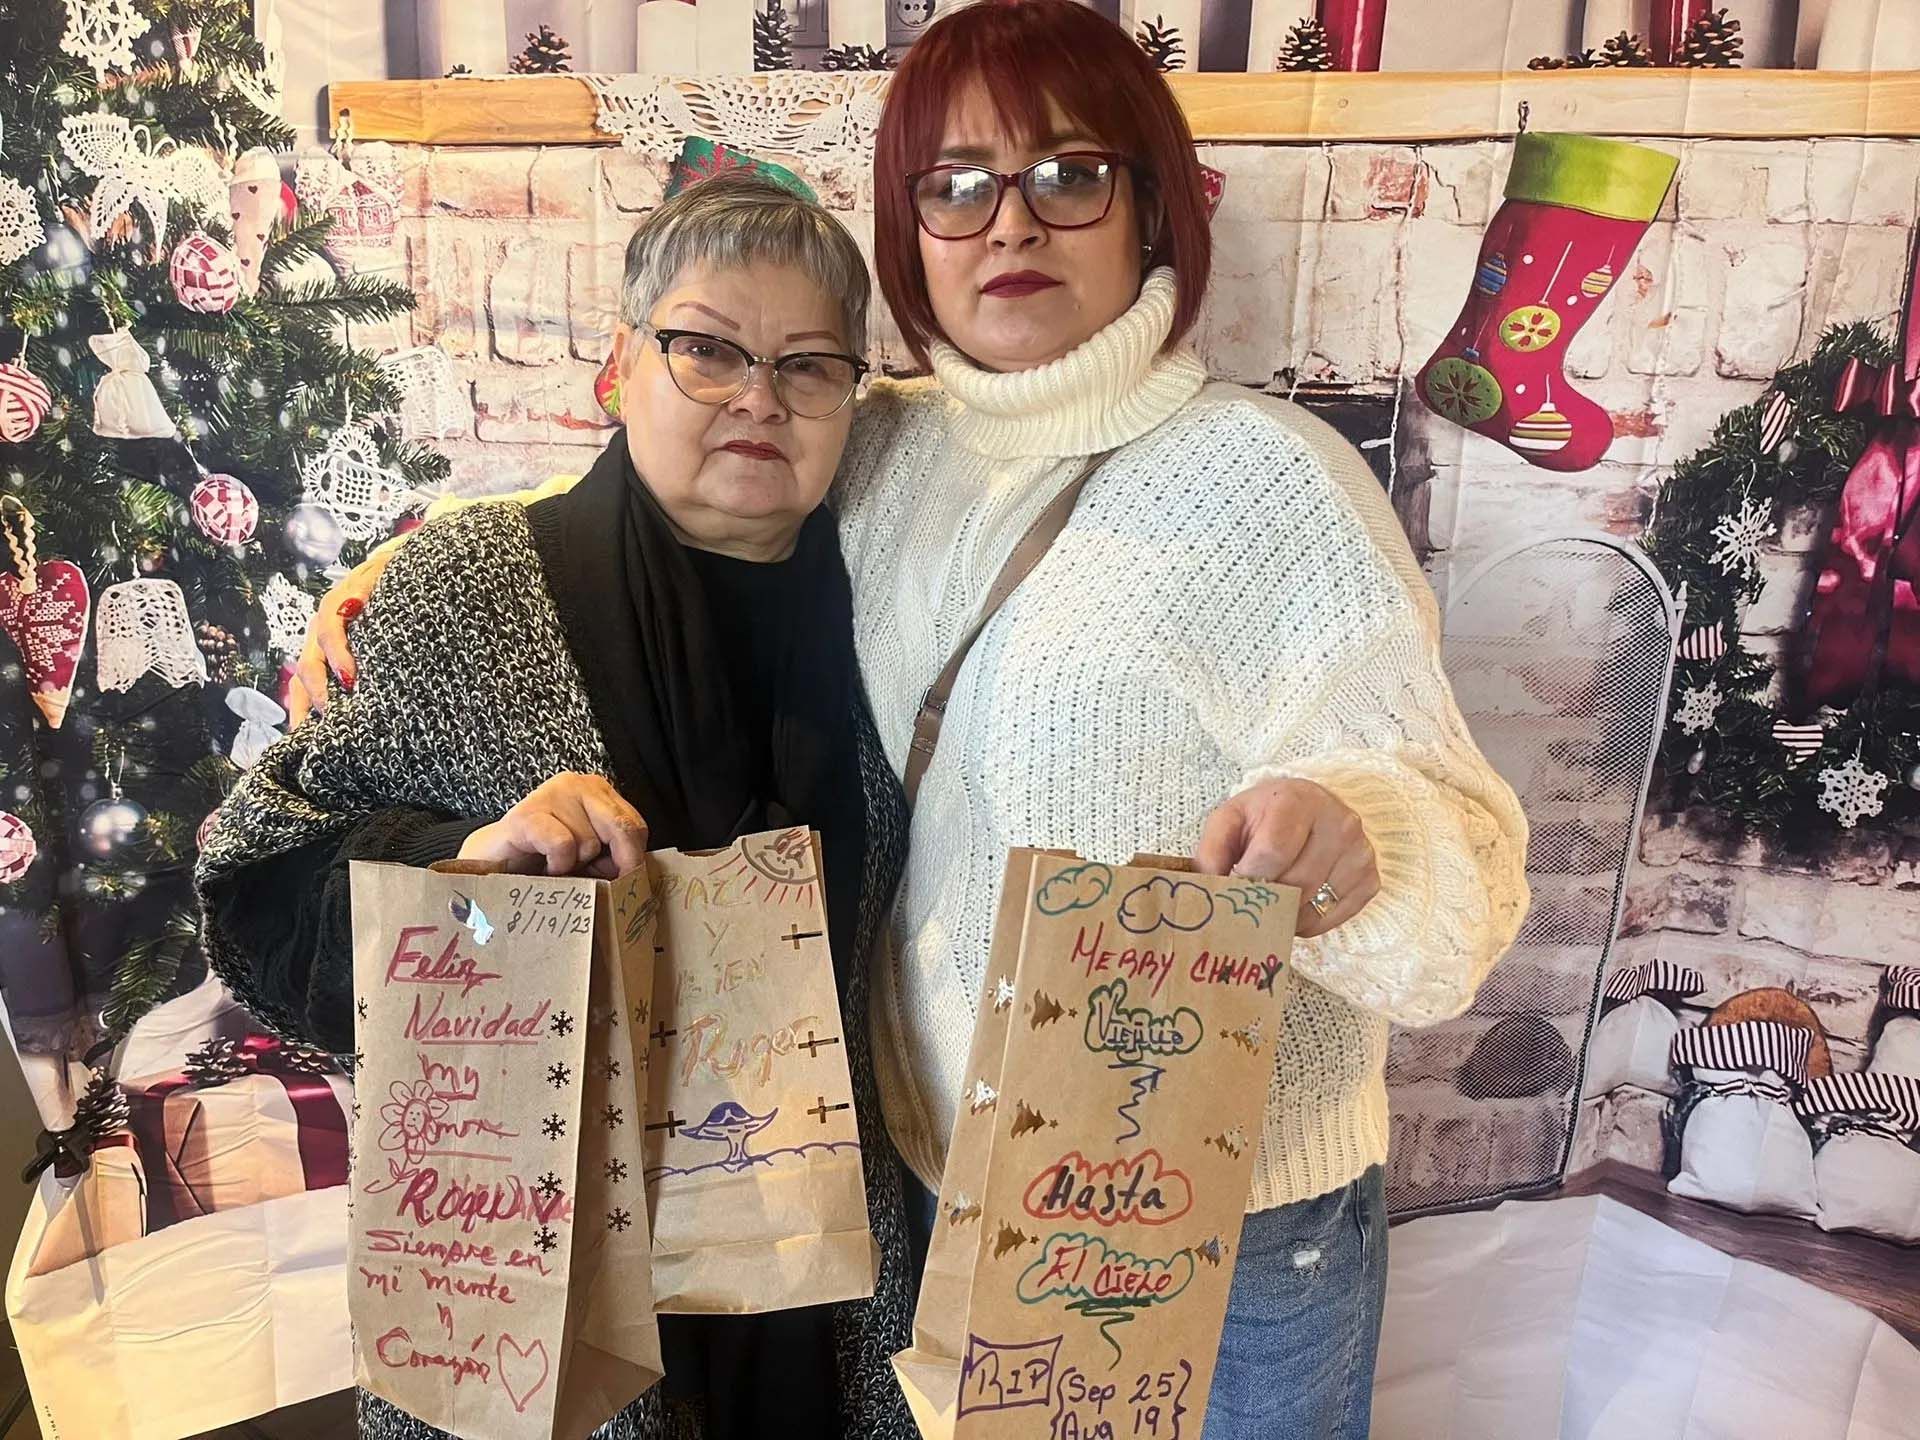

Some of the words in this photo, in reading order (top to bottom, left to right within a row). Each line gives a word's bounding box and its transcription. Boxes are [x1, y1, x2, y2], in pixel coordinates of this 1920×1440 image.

[509, 885, 592, 910] 9/25/42
[507, 909, 592, 937] 8/19/23
[1042, 1164, 1166, 1215] Hasta
[504, 1249, 552, 1276] en
[969, 1351, 1050, 1405] RIP
[1134, 1406, 1160, 1436] 19
